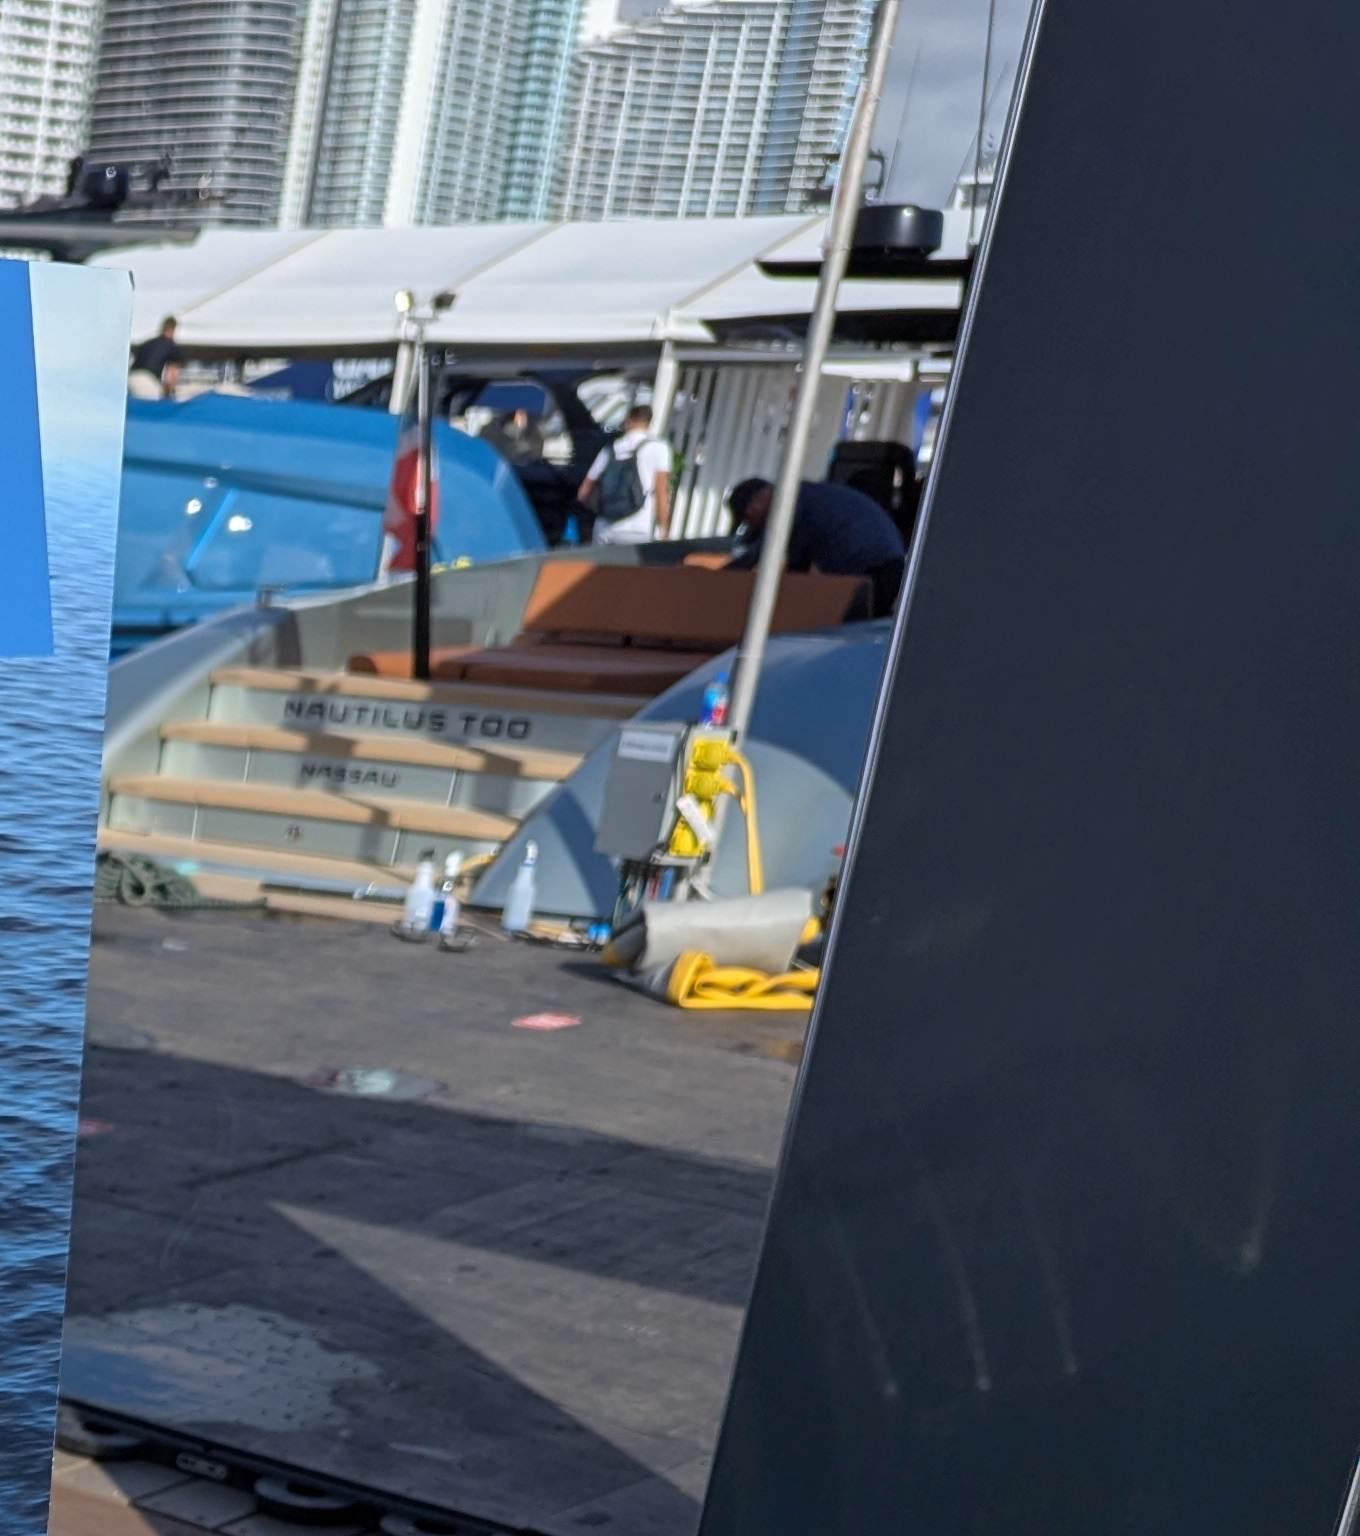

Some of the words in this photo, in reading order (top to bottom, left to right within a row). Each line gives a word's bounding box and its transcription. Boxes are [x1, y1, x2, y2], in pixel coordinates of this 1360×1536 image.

[283, 701, 448, 733] NAUTILUS
[460, 712, 531, 740] TOO
[300, 763, 401, 788] NASSAU
